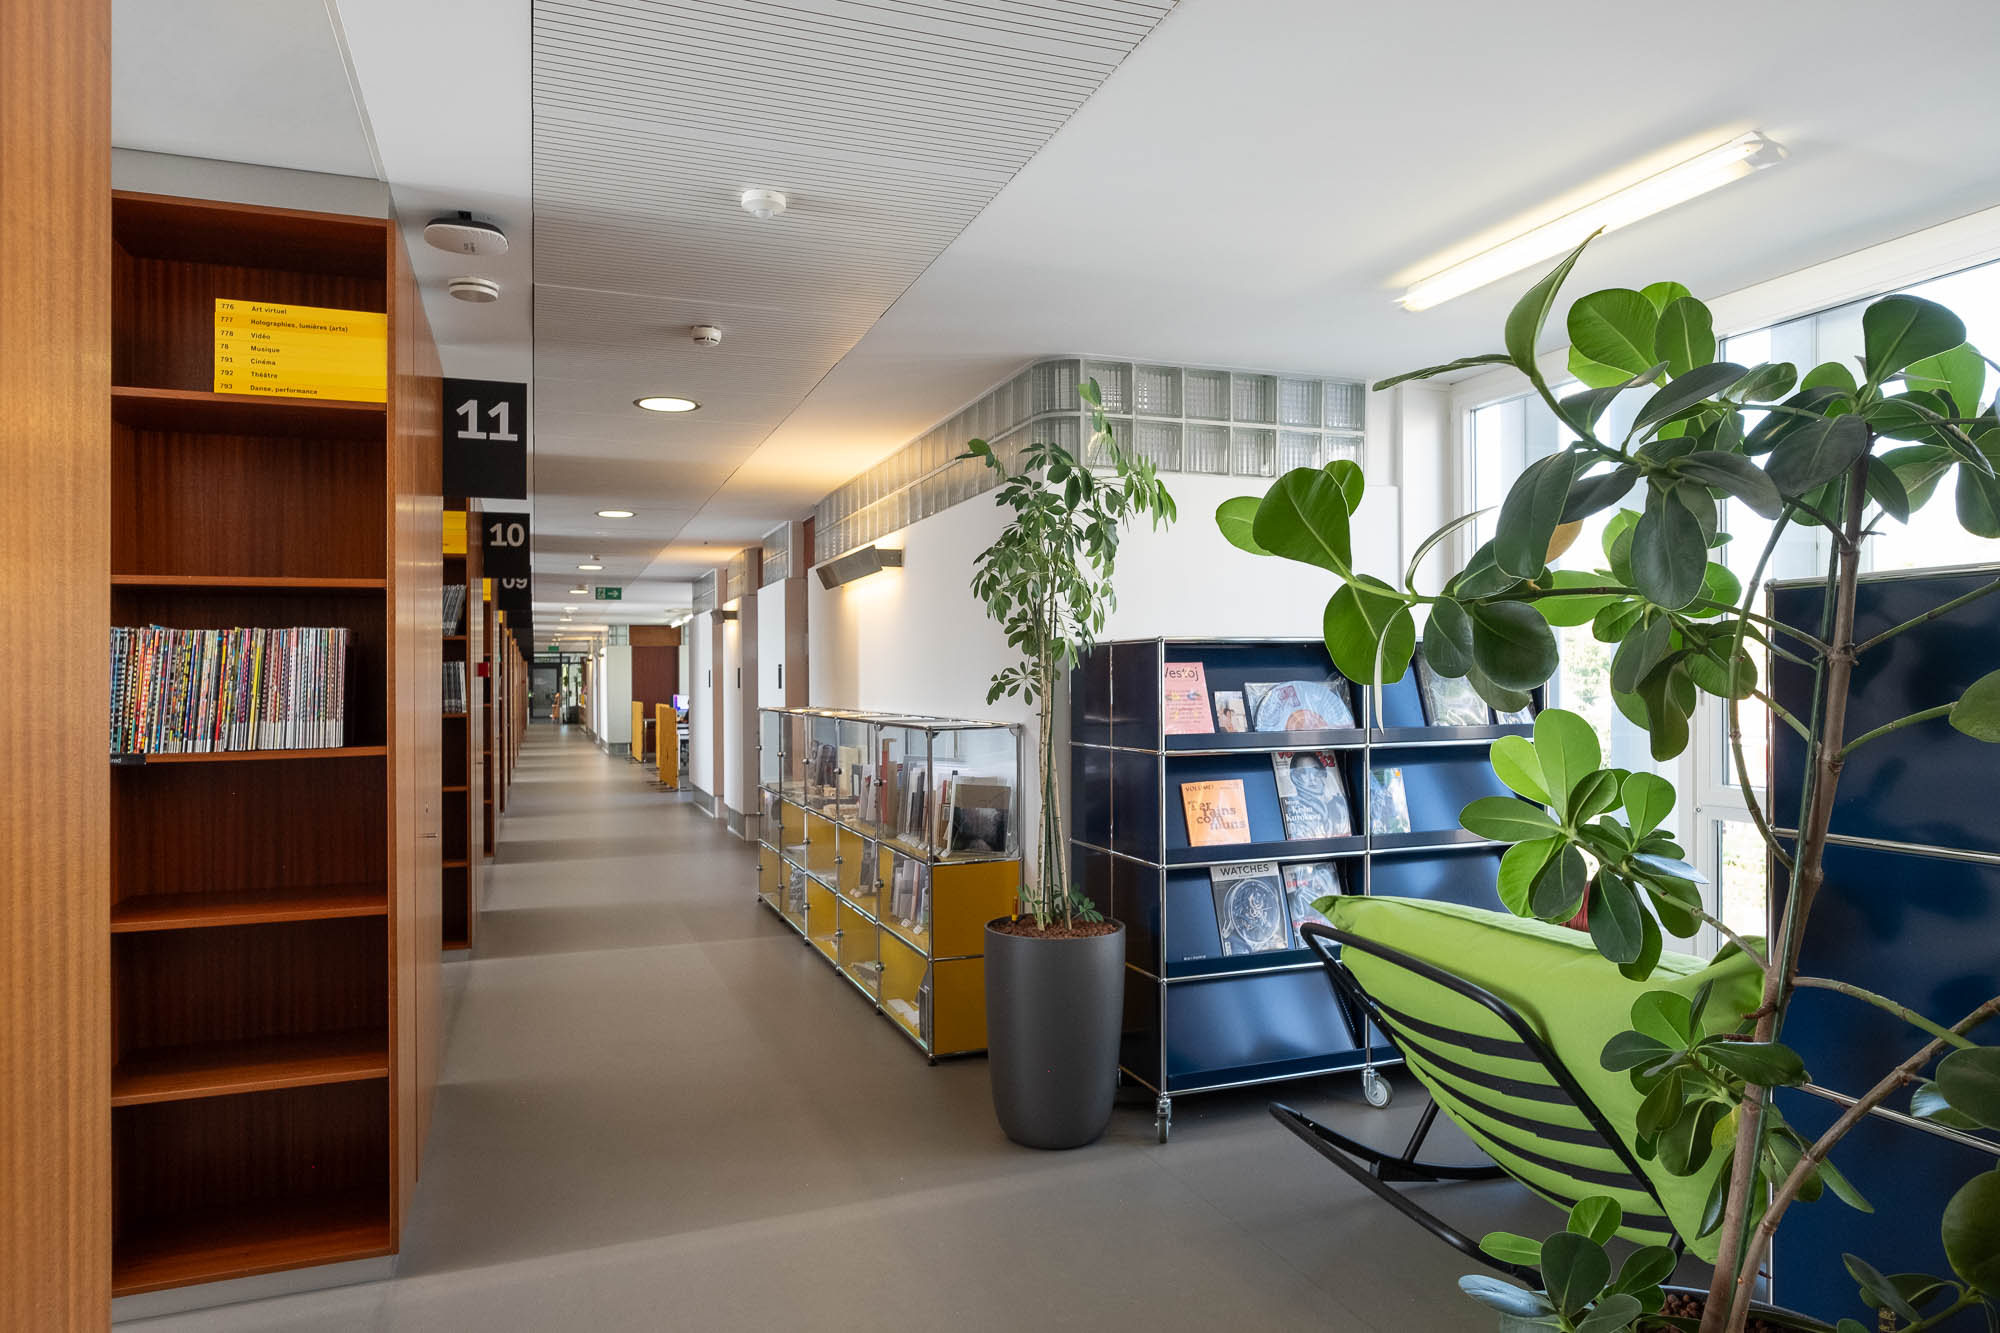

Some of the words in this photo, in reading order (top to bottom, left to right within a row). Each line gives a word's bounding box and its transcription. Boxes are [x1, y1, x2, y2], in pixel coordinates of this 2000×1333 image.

[264, 307, 287, 315] virtuel
[250, 319, 298, 329] Holographies,
[298, 322, 328, 331] lumières
[329, 325, 348, 333] (arts)
[220, 329, 234, 337] 778
[250, 332, 271, 340] Vidéo
[250, 345, 280, 354] Musique
[250, 358, 276, 366] Cinéma
[251, 371, 278, 379] Théâtre
[250, 384, 274, 393] Danse,
[275, 386, 318, 395] performance
[456, 399, 518, 442] 11
[489, 523, 525, 547] 10
[1219, 863, 1270, 877] WATCHES
